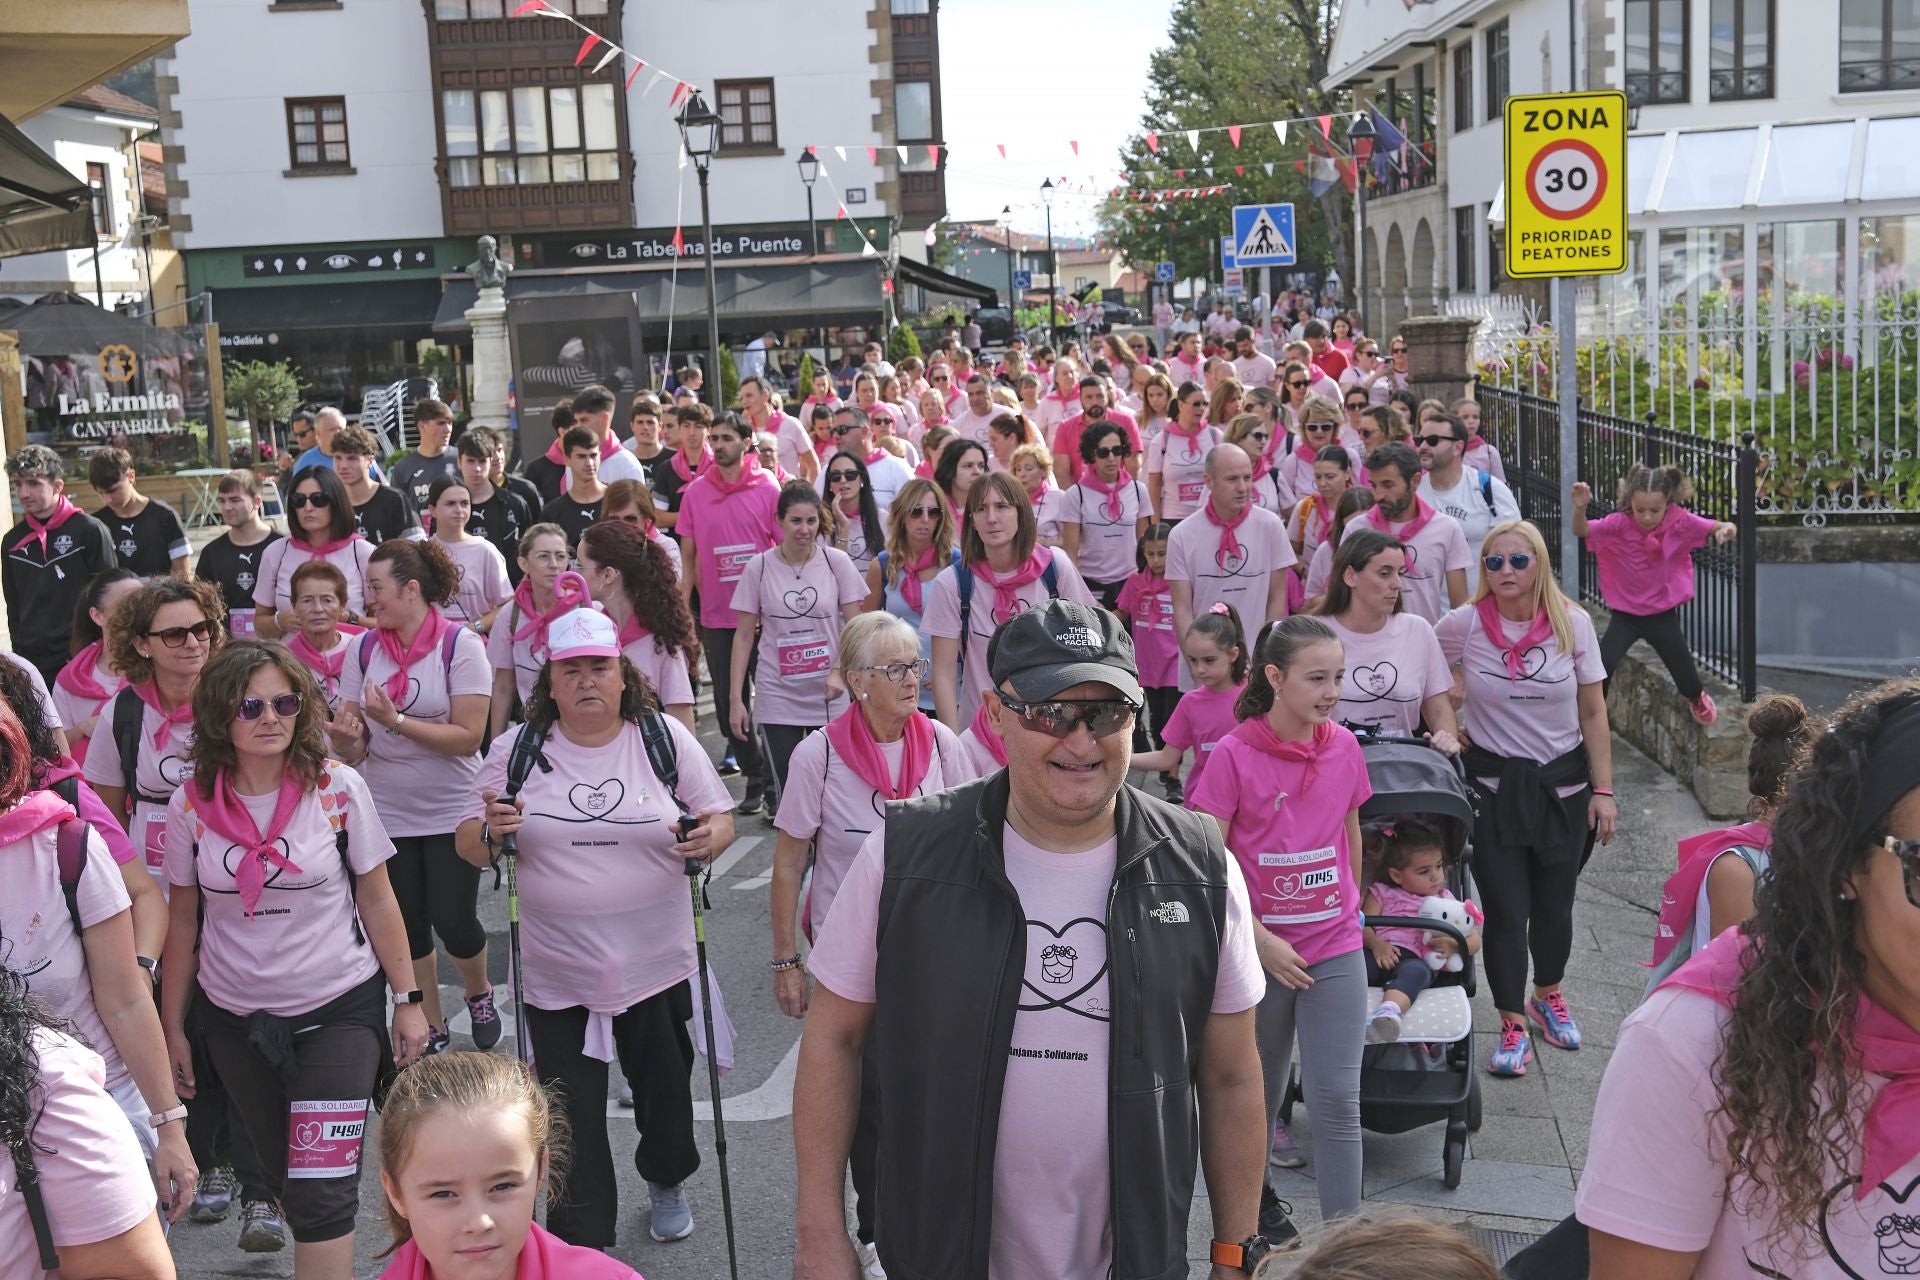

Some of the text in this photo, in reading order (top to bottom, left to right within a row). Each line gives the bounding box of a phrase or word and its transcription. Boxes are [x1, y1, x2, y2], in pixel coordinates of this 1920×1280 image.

[1523, 107, 1609, 132] ZONA
[1545, 167, 1588, 193] 30
[1521, 229, 1612, 244] PRIORIDAD
[606, 243, 627, 259] La
[711, 238, 733, 254] de
[739, 236, 803, 253] Puente
[1522, 246, 1612, 260] PEATONES
[58, 390, 180, 415] La Ermita
[72, 417, 172, 439] CANTABRIA
[1056, 633, 1087, 641] NORTH
[1263, 849, 1333, 865] DORSAL SOLIDARIO
[1304, 869, 1333, 886] 0145
[265, 908, 291, 916] Solidarias
[1150, 908, 1177, 917] NORTH
[1160, 901, 1175, 910] THE
[1160, 915, 1179, 923] FACE
[1044, 1049, 1089, 1062] Solidarias
[292, 1101, 365, 1112] DORSAL SOLIDARIO
[330, 1123, 363, 1138] 1498
